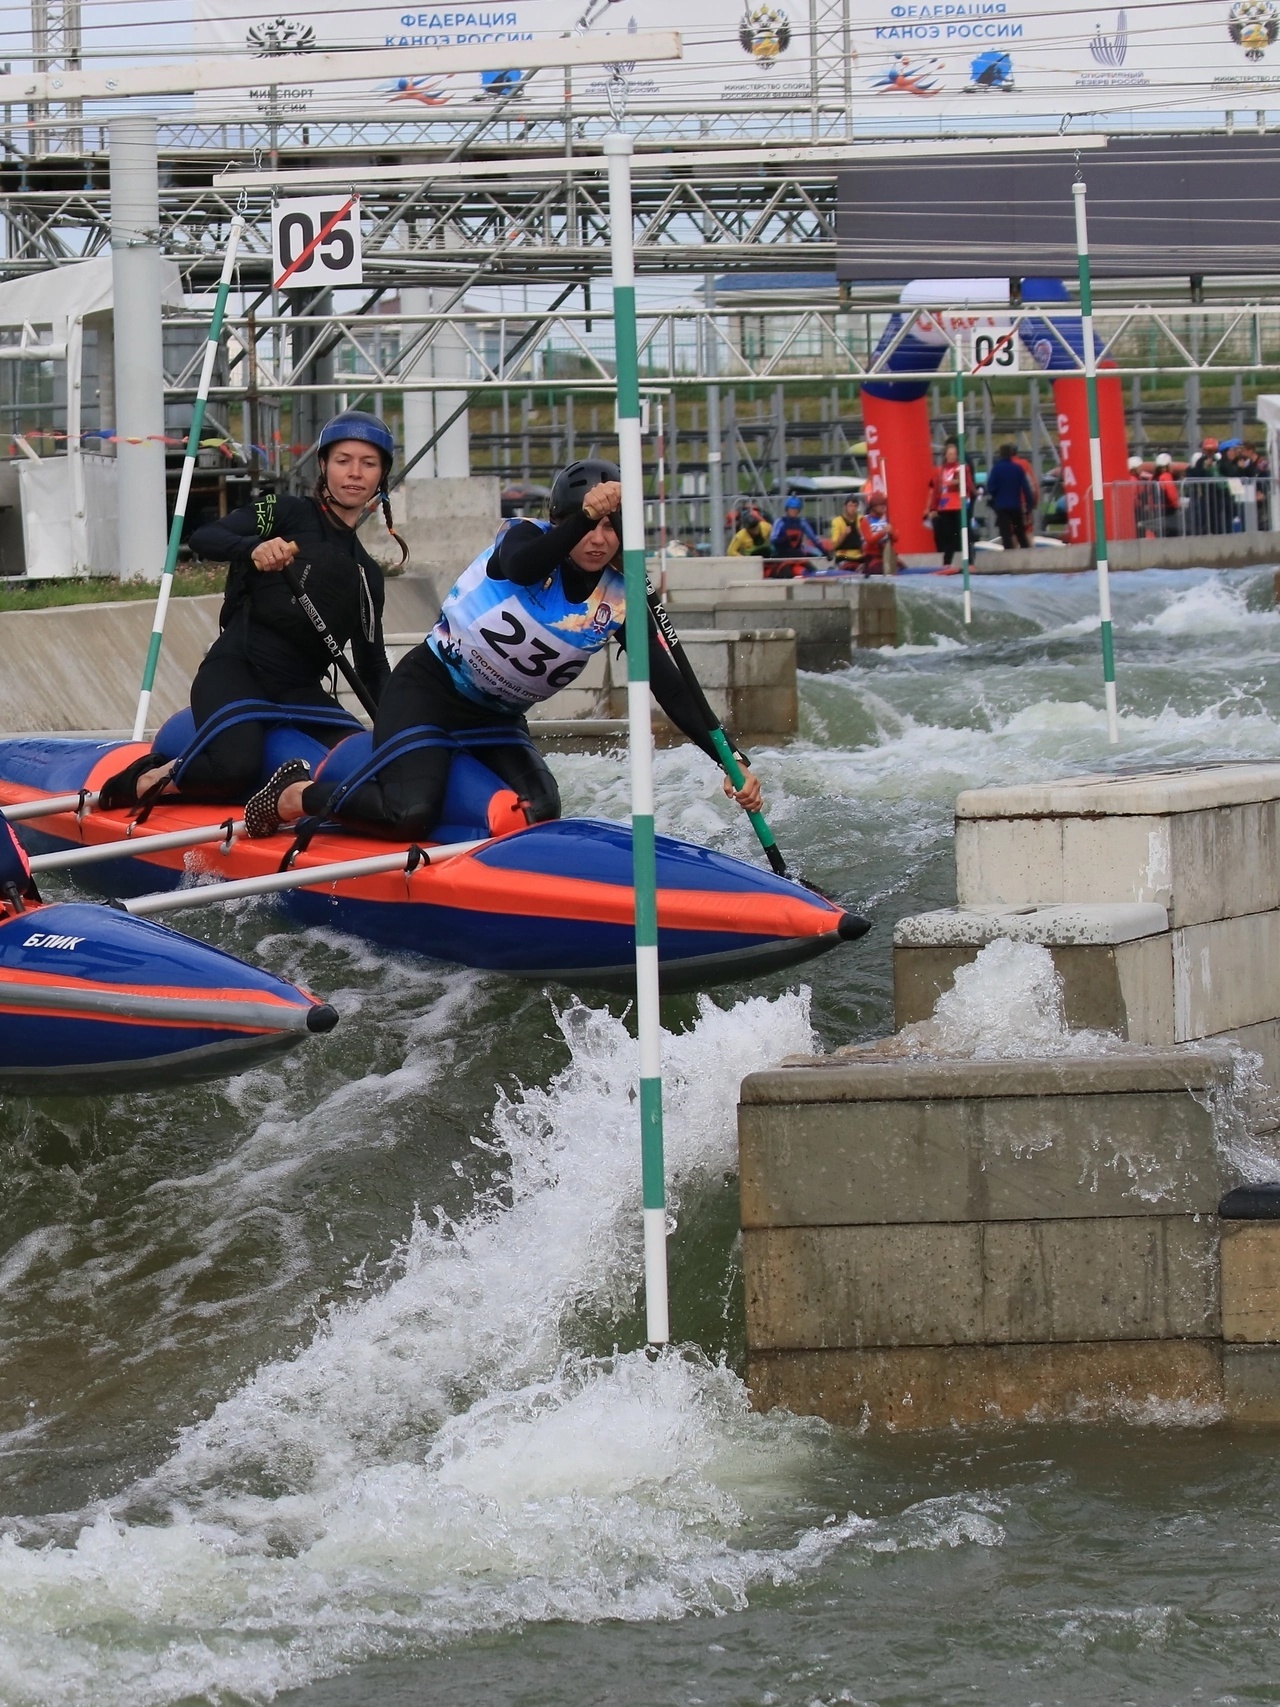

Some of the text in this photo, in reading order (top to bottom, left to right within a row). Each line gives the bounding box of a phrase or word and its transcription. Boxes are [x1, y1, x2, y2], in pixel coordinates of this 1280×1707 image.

[400, 12, 517, 29] ФЕДЕРАЦИЯ
[891, 3, 1007, 19] ФЕДЕРАЦИЯ
[385, 34, 450, 47] КАНОЭ
[876, 24, 1023, 39] КАНОЭ РОССИИ
[724, 83, 781, 91] МИНИСТЕРСТВО
[279, 209, 355, 273] 05
[975, 334, 1015, 367] 03
[865, 424, 886, 494] СТА
[1057, 413, 1081, 538] СТАРТ
[653, 602, 679, 648] KALINA
[323, 633, 343, 658] BOLT
[479, 610, 589, 688] 236
[470, 649, 521, 693] СПОРТИВНЫЙ
[22, 932, 87, 951] БЛИК
